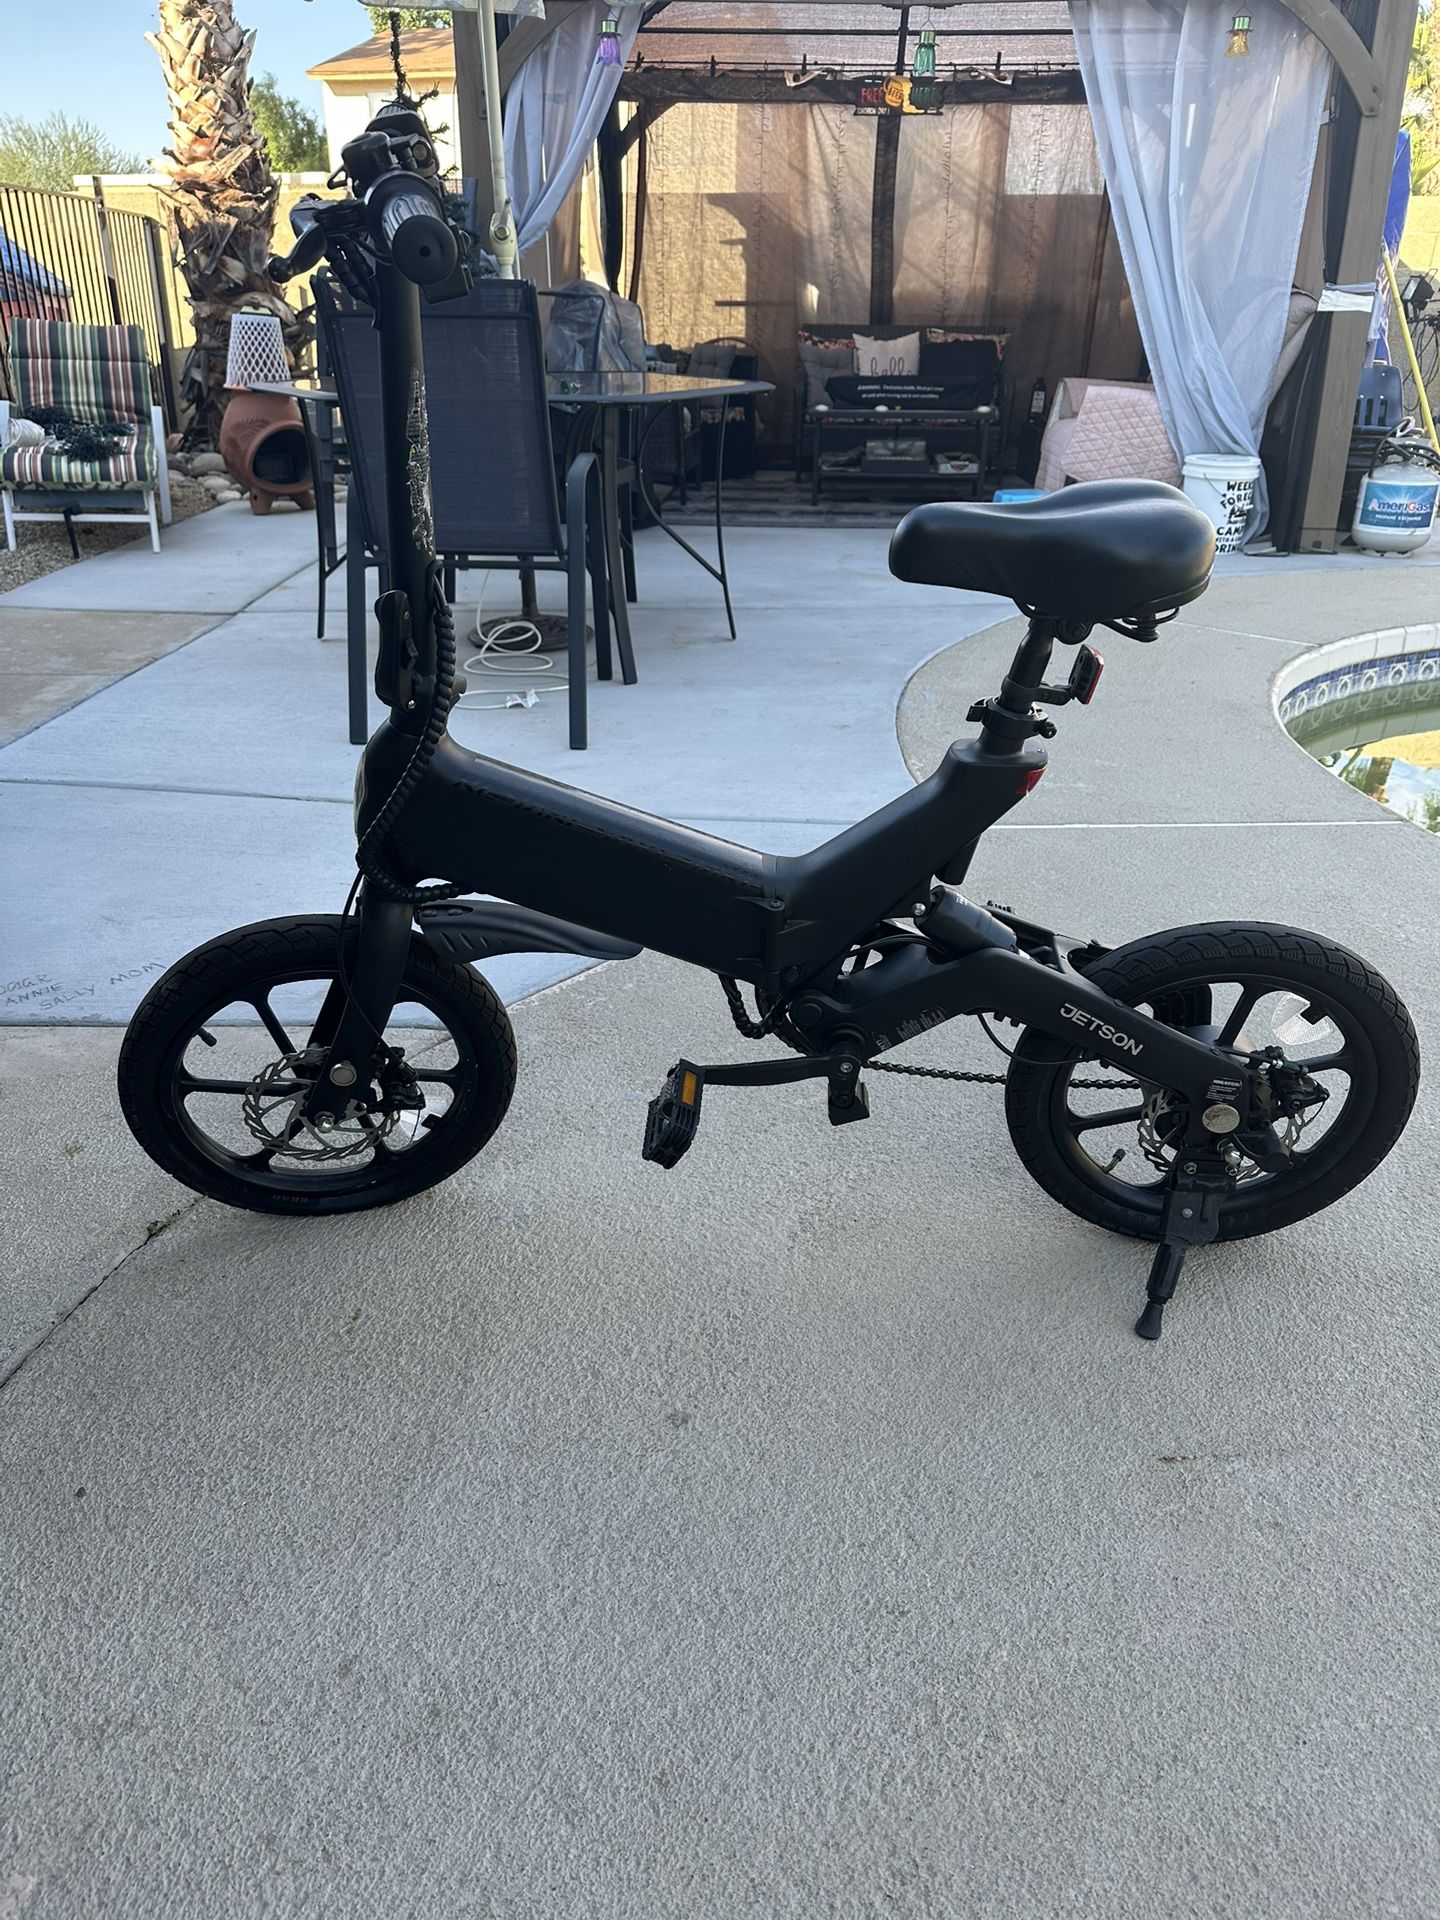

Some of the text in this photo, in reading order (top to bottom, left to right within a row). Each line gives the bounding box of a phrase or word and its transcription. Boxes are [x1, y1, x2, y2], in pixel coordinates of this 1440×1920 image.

[1368, 499, 1430, 513] AmeriGas
[110, 962, 167, 985] MOM
[40, 984, 95, 1011] SALLY
[1060, 1003, 1144, 1056] JETSON
